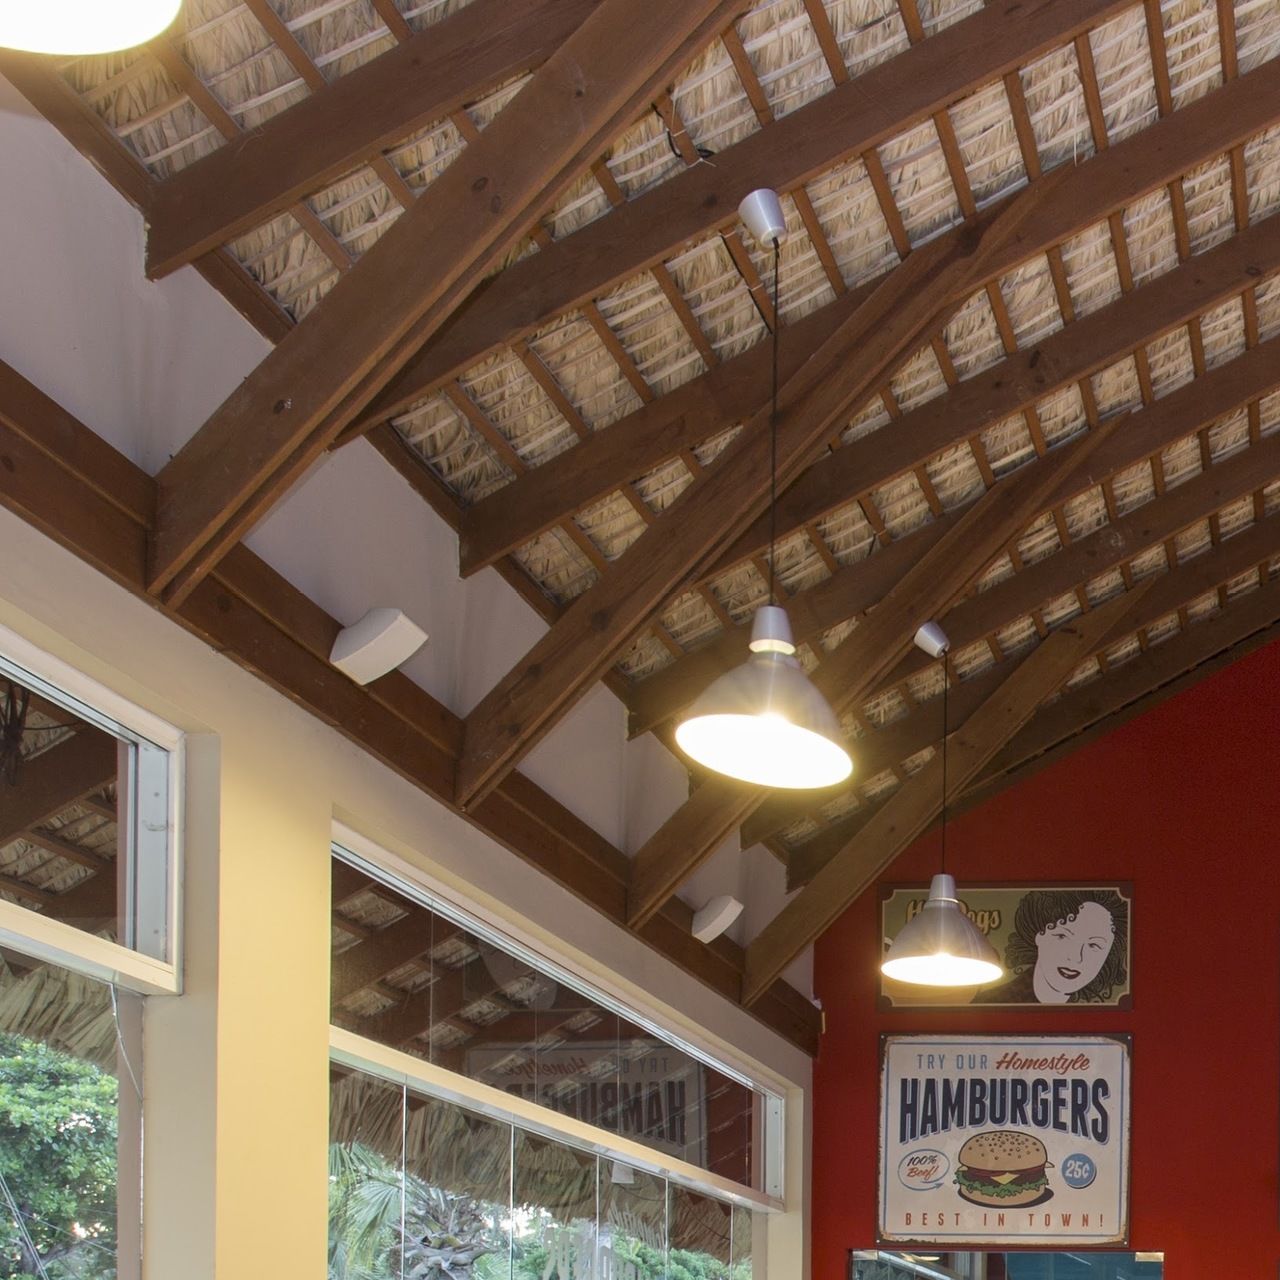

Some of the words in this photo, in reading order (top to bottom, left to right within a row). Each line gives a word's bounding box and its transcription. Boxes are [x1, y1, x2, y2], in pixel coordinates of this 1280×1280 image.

[917, 1054, 946, 1070] TRY
[956, 1054, 988, 1070] OUR
[995, 1052, 1091, 1075] Homestyle
[899, 1078, 1111, 1145] HAMBURGERS
[907, 1155, 938, 1166] 100%
[907, 1165, 939, 1180] Beef!
[1065, 1160, 1090, 1179] 25¢
[905, 1213, 961, 1227] BEST
[983, 1213, 1005, 1227] IN
[1029, 1213, 1104, 1227] TOWN!
